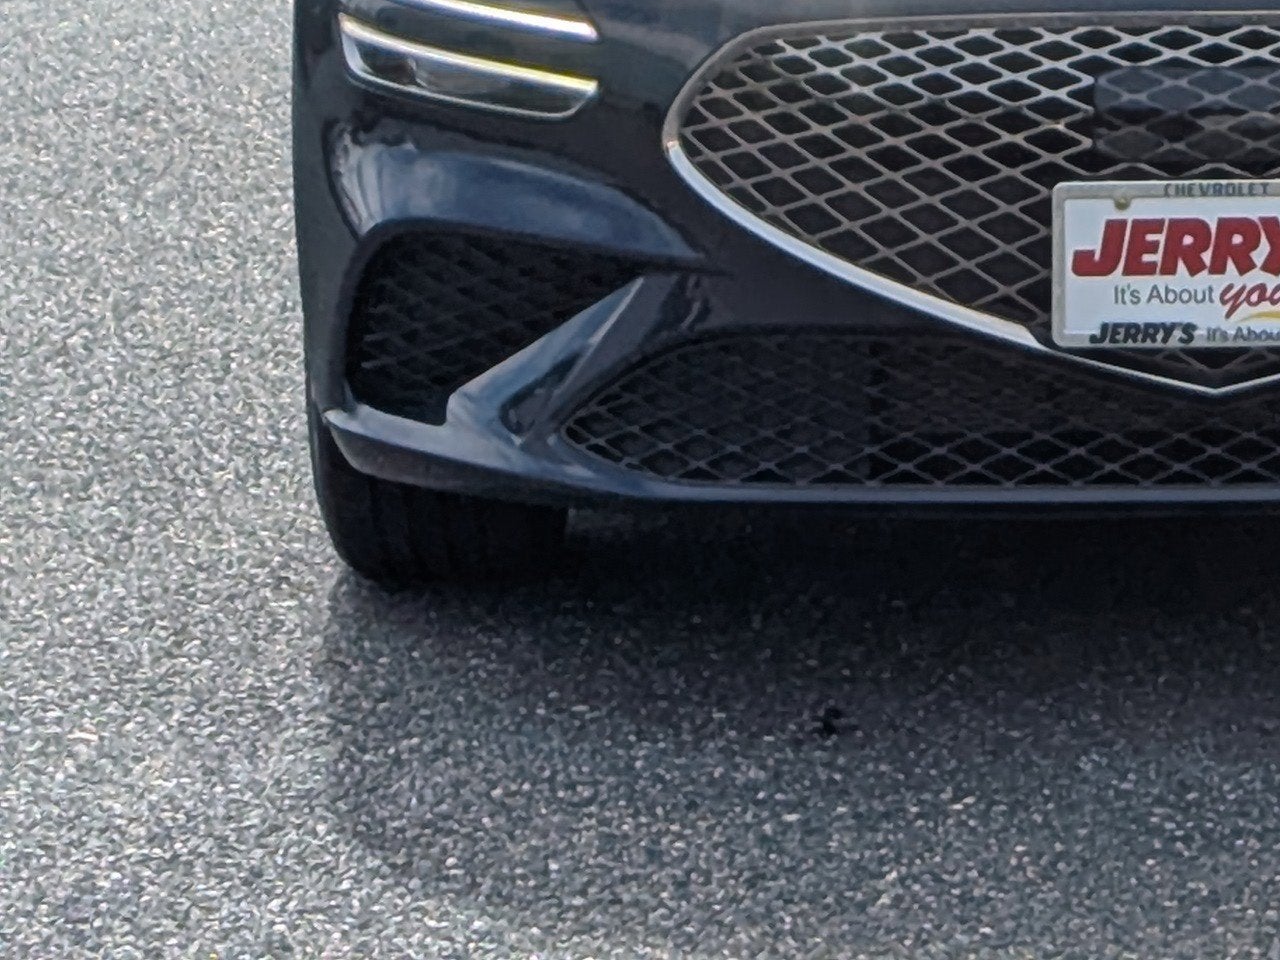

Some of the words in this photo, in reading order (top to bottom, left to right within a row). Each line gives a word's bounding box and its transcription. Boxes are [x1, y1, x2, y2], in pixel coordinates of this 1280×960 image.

[1163, 182, 1271, 197] CHEVROLET
[1114, 283, 1141, 305] It's
[1146, 284, 1215, 305] About
[1089, 321, 1198, 344] JERRY'S
[1206, 326, 1230, 342] It's
